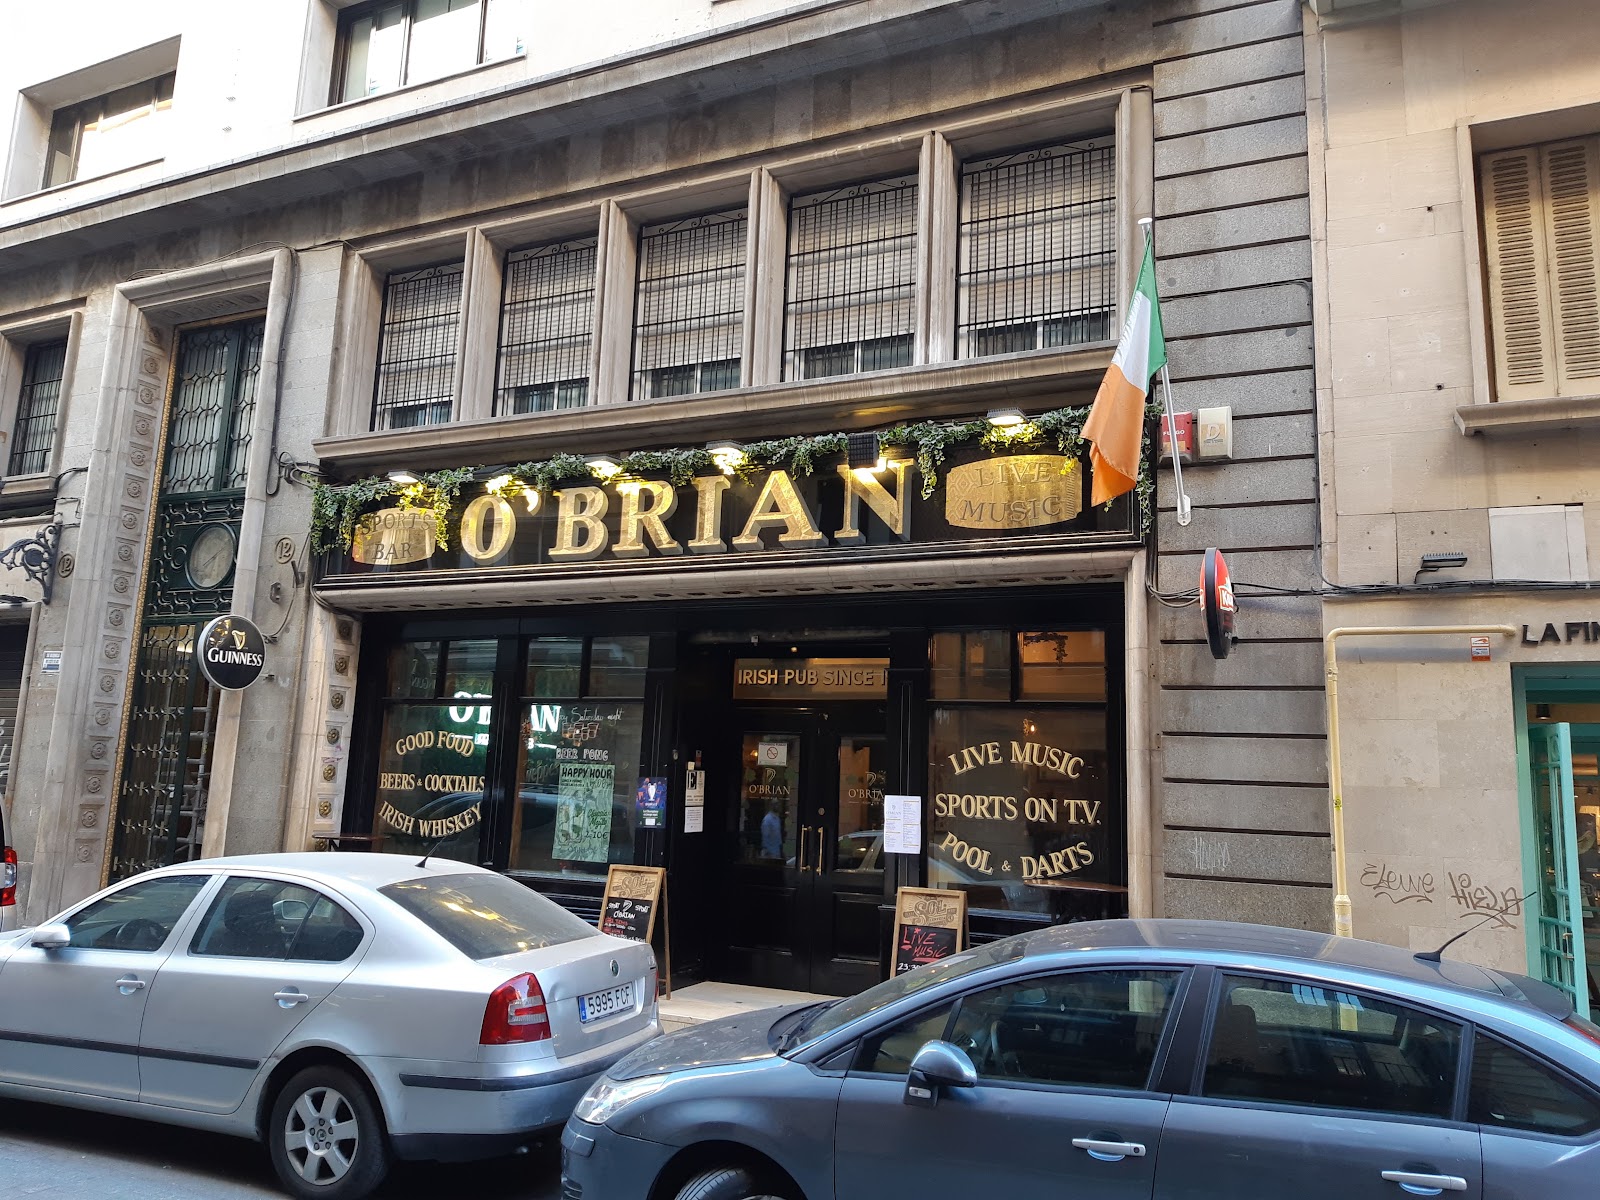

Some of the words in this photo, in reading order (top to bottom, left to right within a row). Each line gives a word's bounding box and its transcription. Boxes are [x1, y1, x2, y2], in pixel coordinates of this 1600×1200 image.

[975, 461, 1052, 488] LIVE
[460, 458, 920, 566] O'BRIAN
[960, 494, 1061, 522] MUSIC
[361, 512, 431, 536] SPORTS
[279, 542, 291, 559] 12
[372, 542, 412, 560] BAR
[60, 558, 72, 573] 12
[1521, 622, 1561, 644] LA
[207, 647, 263, 667] GUINNESS
[738, 669, 778, 685] IRISH
[784, 669, 818, 685] PUB
[822, 670, 874, 686] SINCE
[396, 731, 434, 756] GOOD
[437, 731, 475, 757] FOOD
[556, 748, 578, 760] BEER
[583, 749, 609, 761] PONG
[948, 741, 1003, 776] LIVE
[1010, 740, 1084, 779] MUSIC
[379, 772, 415, 790] BEERS
[417, 778, 423, 787] &
[425, 774, 485, 793] COCKTAILS
[562, 767, 588, 778] HAPPY
[589, 769, 613, 780] HOUR
[749, 784, 790, 795] O'BRIAN
[848, 788, 885, 799] O'BRIA
[378, 801, 415, 835] IRISH
[419, 802, 482, 838] WHISKEY
[935, 793, 1018, 820] SPORTS
[1024, 797, 1058, 824] ON
[1063, 799, 1102, 825] T.V.
[938, 831, 994, 876] POOL
[1001, 859, 1012, 872] &
[1020, 841, 1094, 880] DARTS
[914, 901, 947, 923] SOL
[913, 945, 948, 957] MUSIC
[588, 991, 614, 1015] 5995
[615, 986, 630, 1007] FCF
